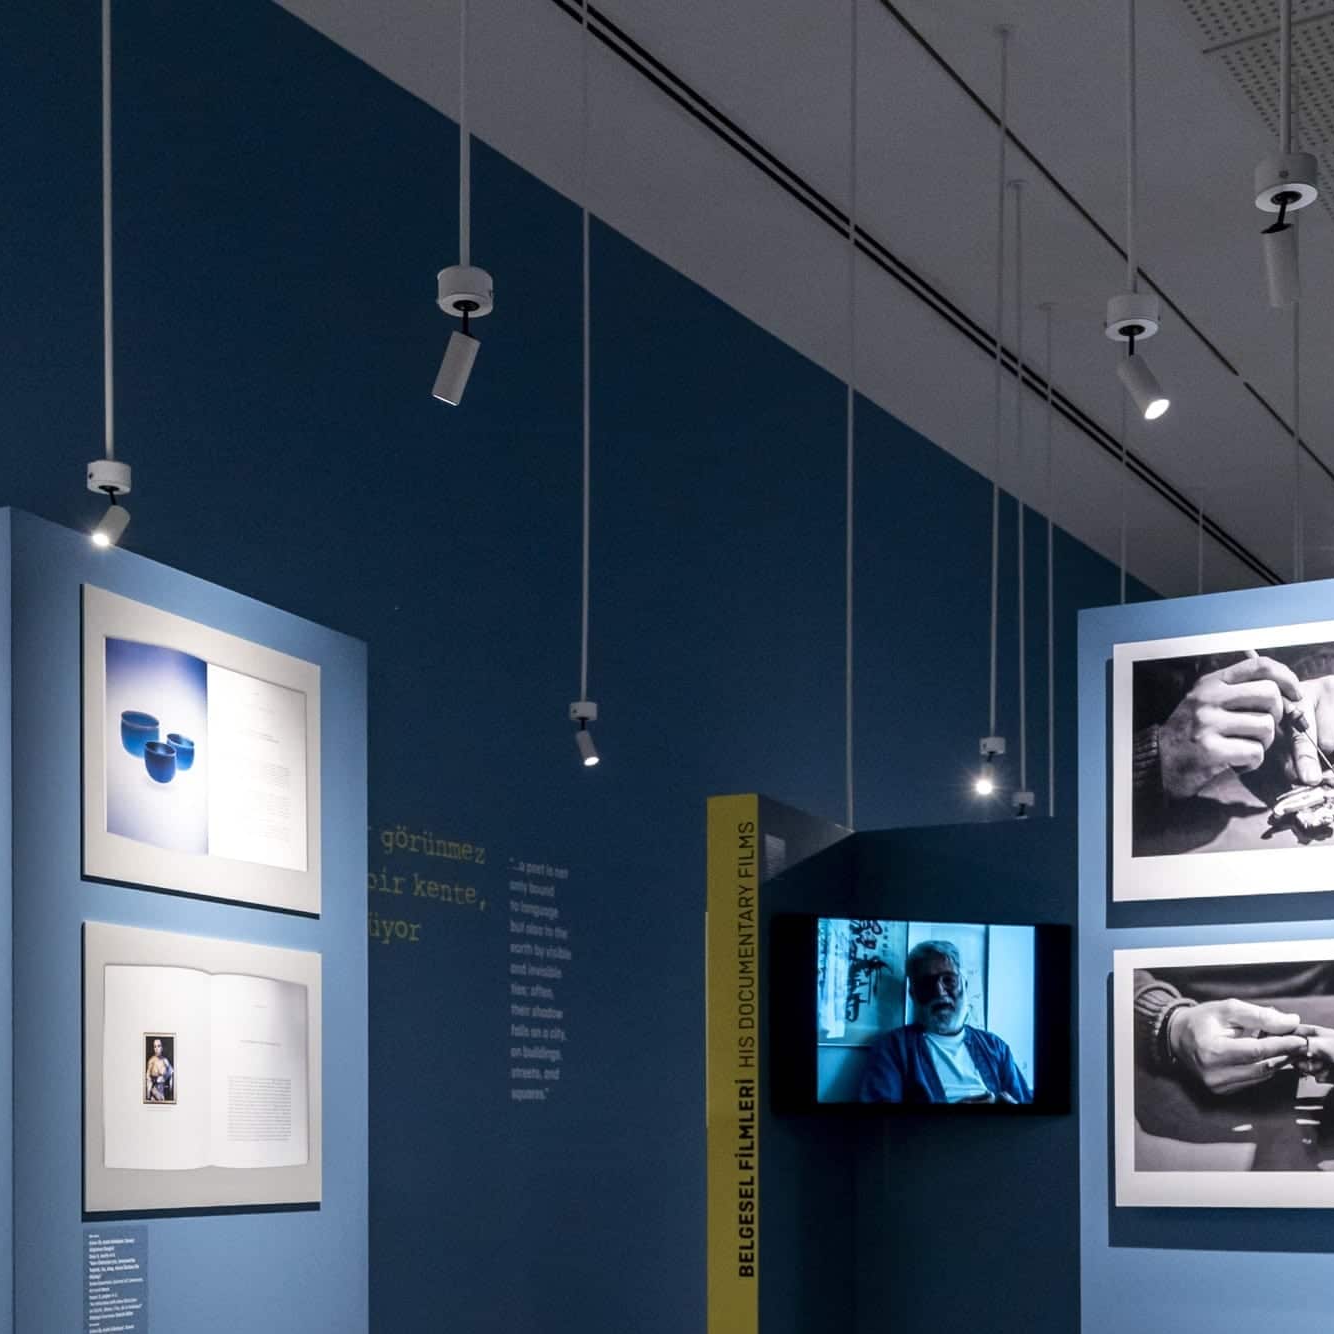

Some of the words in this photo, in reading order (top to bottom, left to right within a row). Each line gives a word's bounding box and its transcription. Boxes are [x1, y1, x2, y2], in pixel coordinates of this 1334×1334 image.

[381, 825, 486, 864] görünmez
[739, 821, 755, 878] FILMS
[413, 872, 487, 912] kente,
[739, 885, 755, 1029] DOCUMENTARY
[739, 1036, 755, 1067] HIS
[735, 1080, 755, 1170] FİLMLERİ
[739, 1176, 755, 1278] BELGESEL
